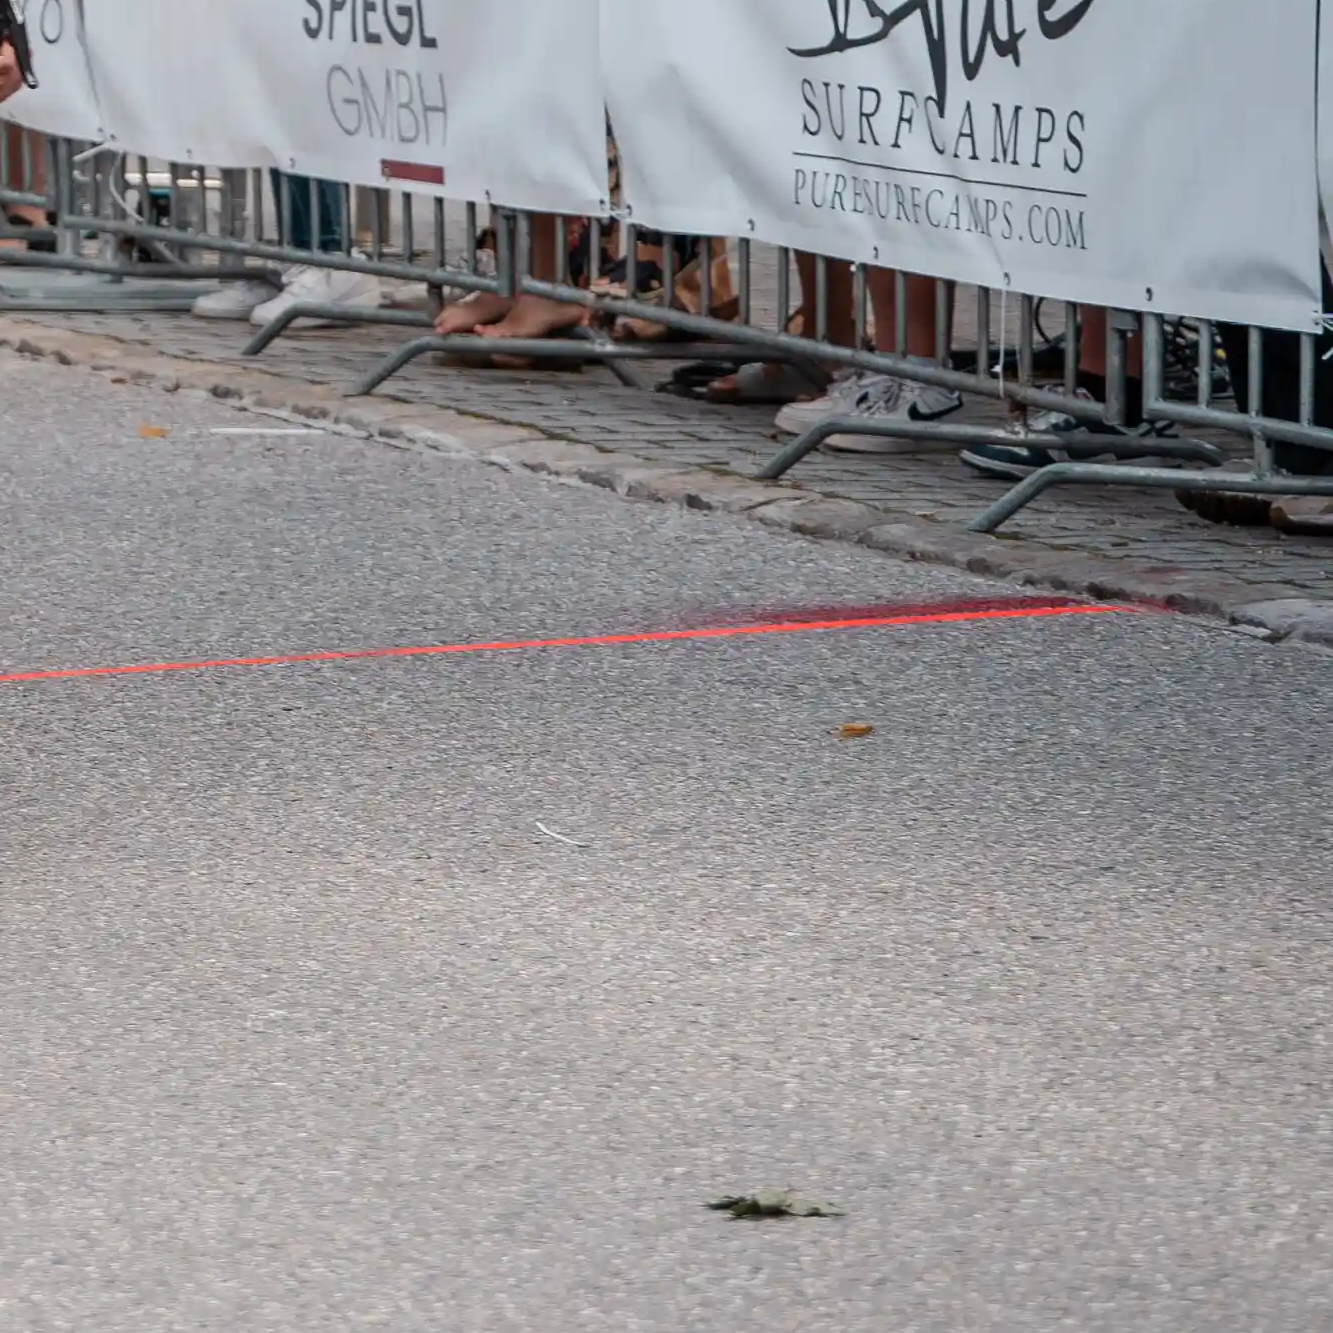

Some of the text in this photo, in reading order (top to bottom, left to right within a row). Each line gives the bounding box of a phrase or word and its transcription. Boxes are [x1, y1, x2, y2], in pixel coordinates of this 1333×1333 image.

[325, 64, 449, 148] GMBH
[799, 77, 1087, 175] SURFCAMPS
[792, 167, 1089, 252] PURESURFCAMPS.COM
